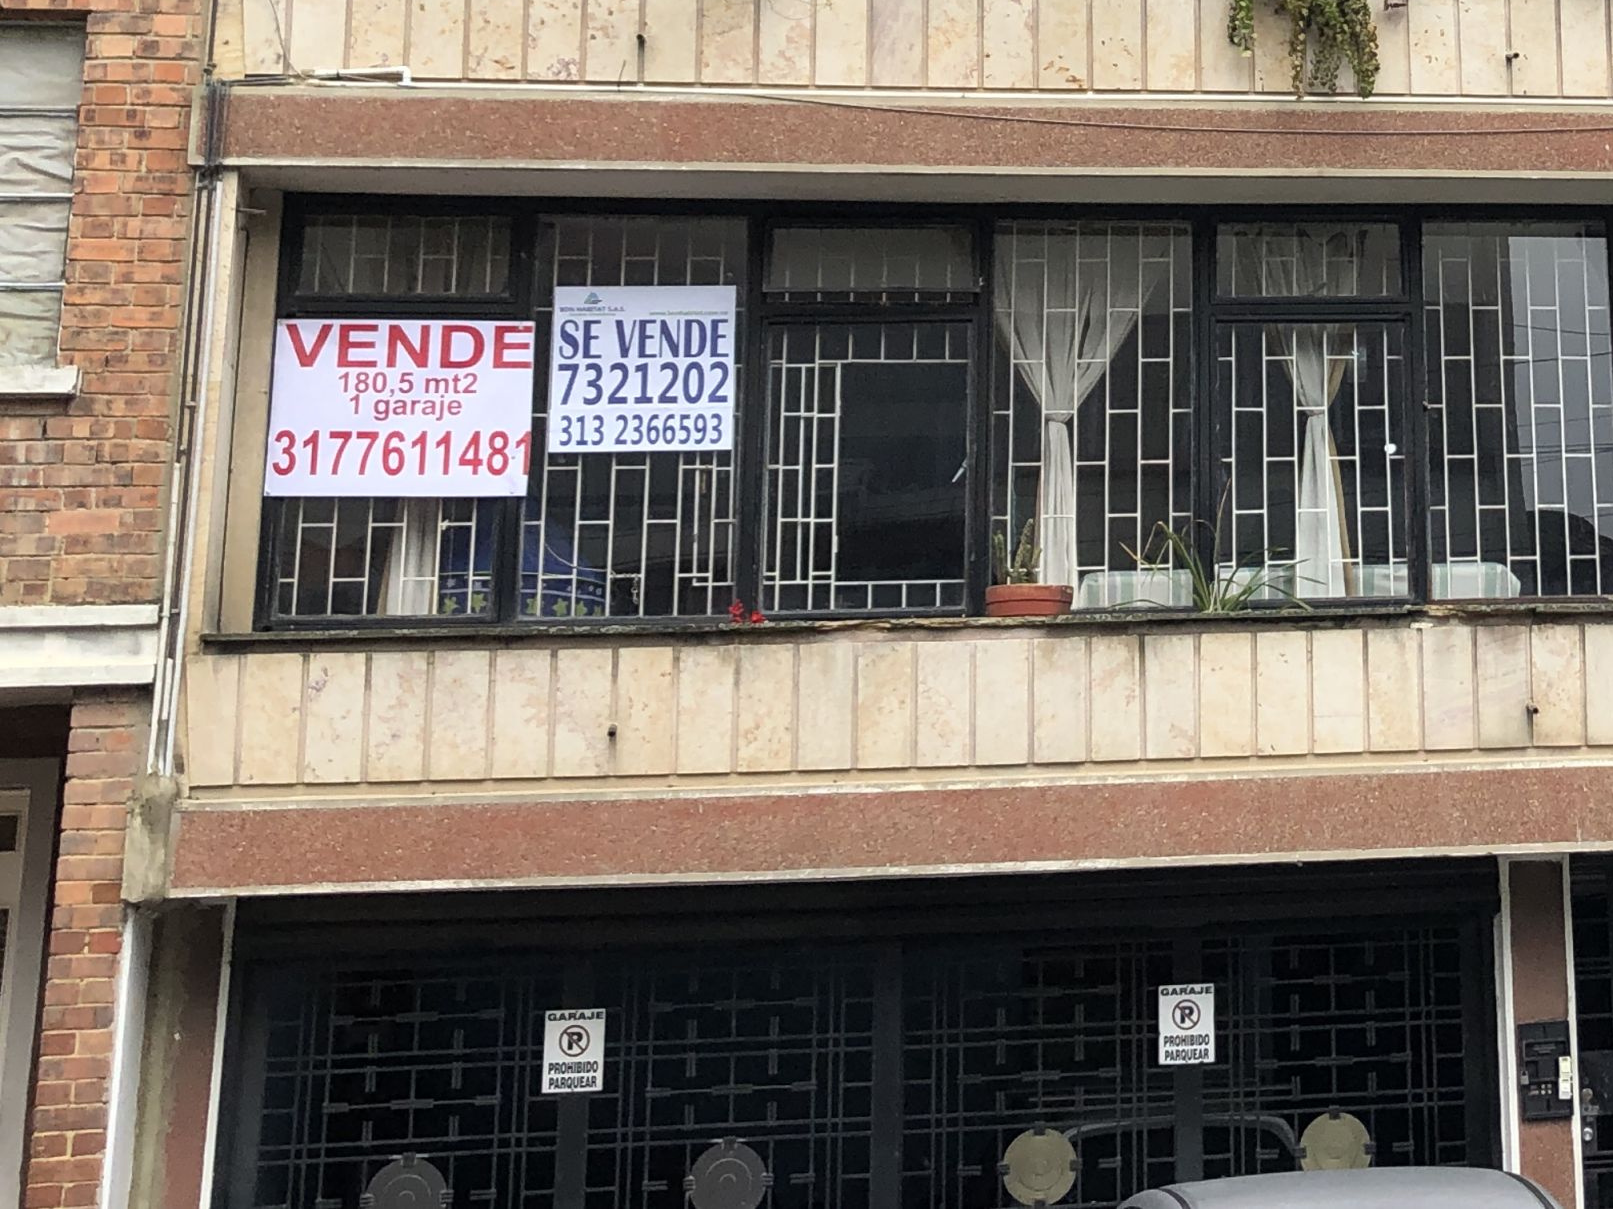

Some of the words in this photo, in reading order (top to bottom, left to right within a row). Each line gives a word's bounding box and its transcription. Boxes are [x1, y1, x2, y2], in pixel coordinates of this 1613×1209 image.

[286, 323, 534, 369] VENDE
[559, 319, 602, 360] SE
[615, 318, 729, 359] VENDE
[337, 372, 414, 397] 180,5
[424, 372, 478, 394] mt2
[557, 361, 729, 406] 7321202
[349, 394, 360, 415] 1
[373, 395, 463, 421] garaje
[559, 414, 604, 446] 313
[614, 413, 723, 446] 2366593
[272, 429, 533, 477] 3177611481
[1160, 985, 1214, 996] GARAJE
[547, 1011, 604, 1021] GARAJE
[1163, 1033, 1210, 1047] PROHIBIDO
[547, 1060, 599, 1075] PROHIBIDO
[1164, 1048, 1210, 1062] PARQUEAR
[548, 1075, 598, 1090] PARQUEAR
